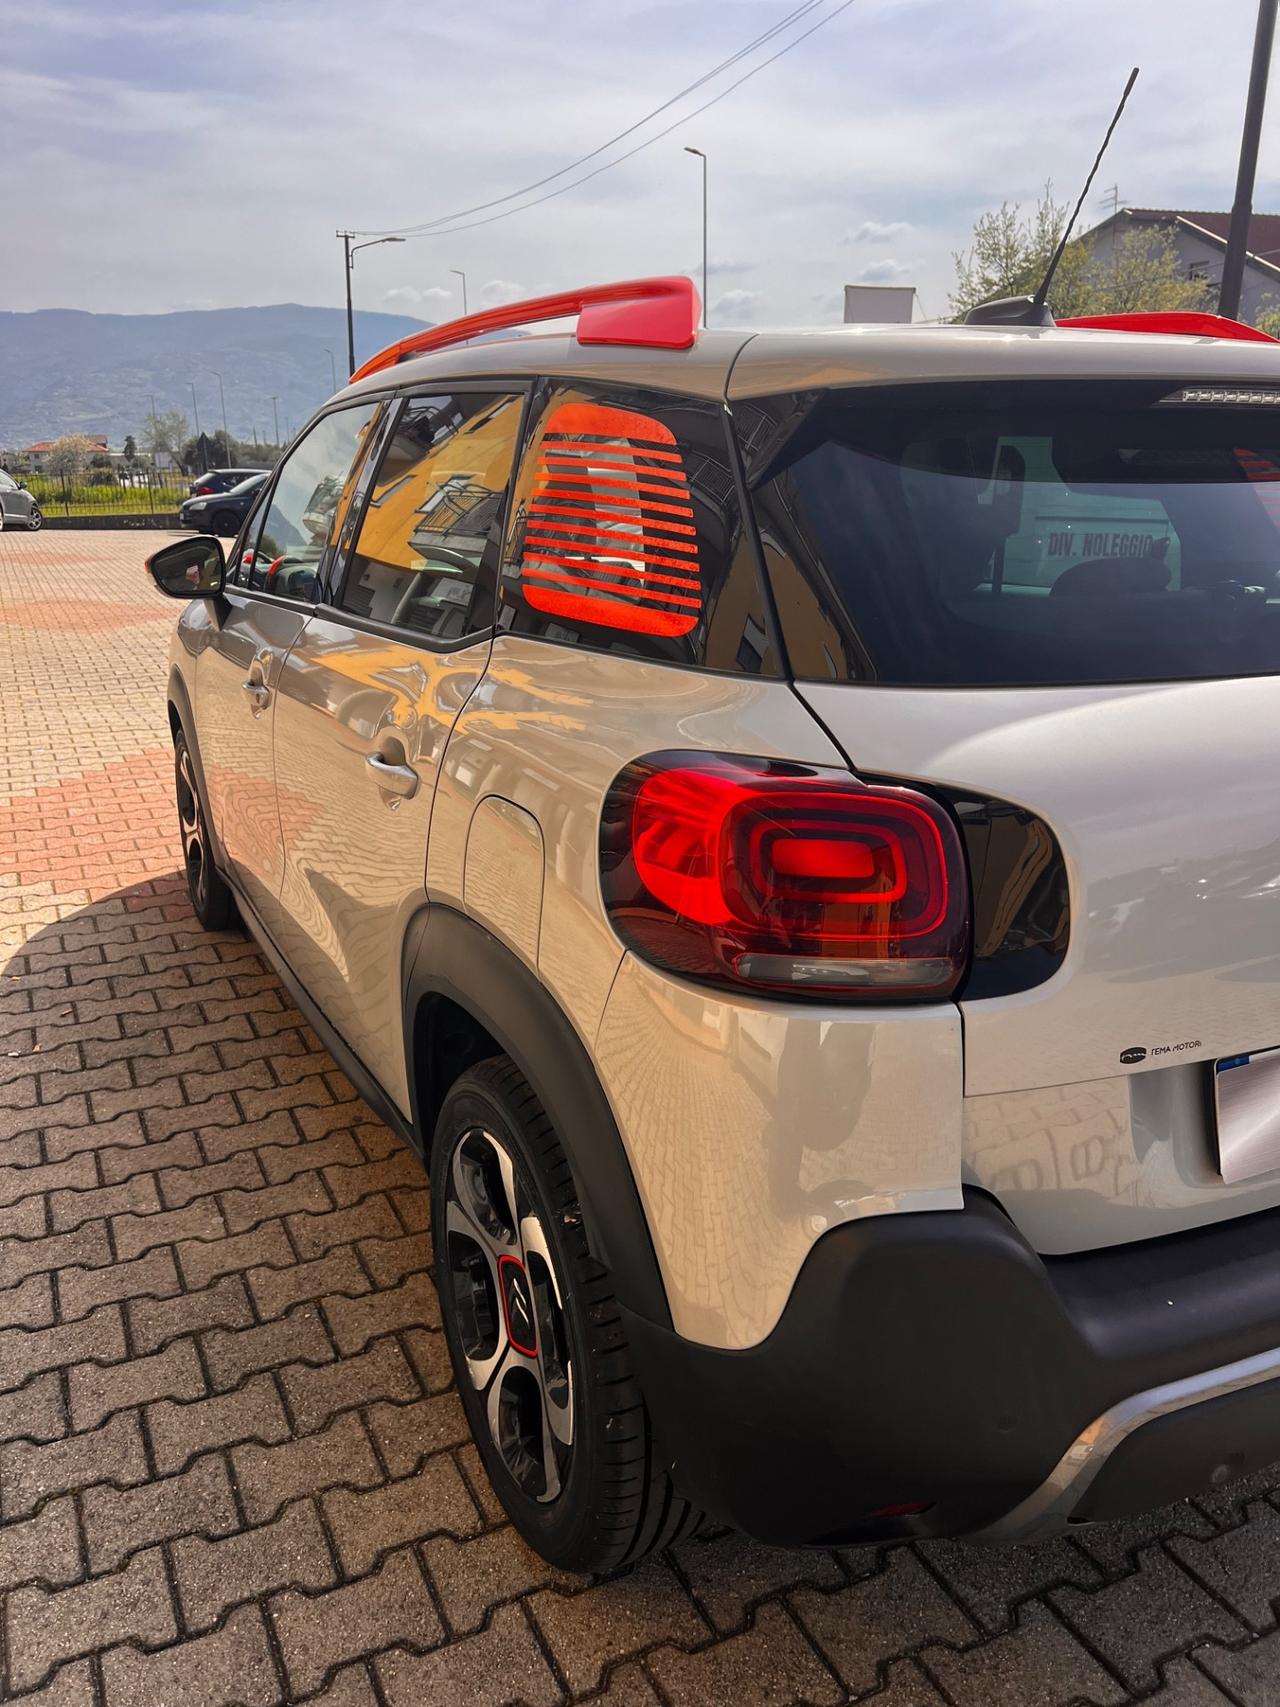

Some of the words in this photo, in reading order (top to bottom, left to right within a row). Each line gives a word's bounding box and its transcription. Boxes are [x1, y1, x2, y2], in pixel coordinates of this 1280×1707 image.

[1048, 532, 1077, 556] DIV.
[1082, 533, 1153, 559] NOLEGGIO
[1151, 1046, 1171, 1056] TEMA
